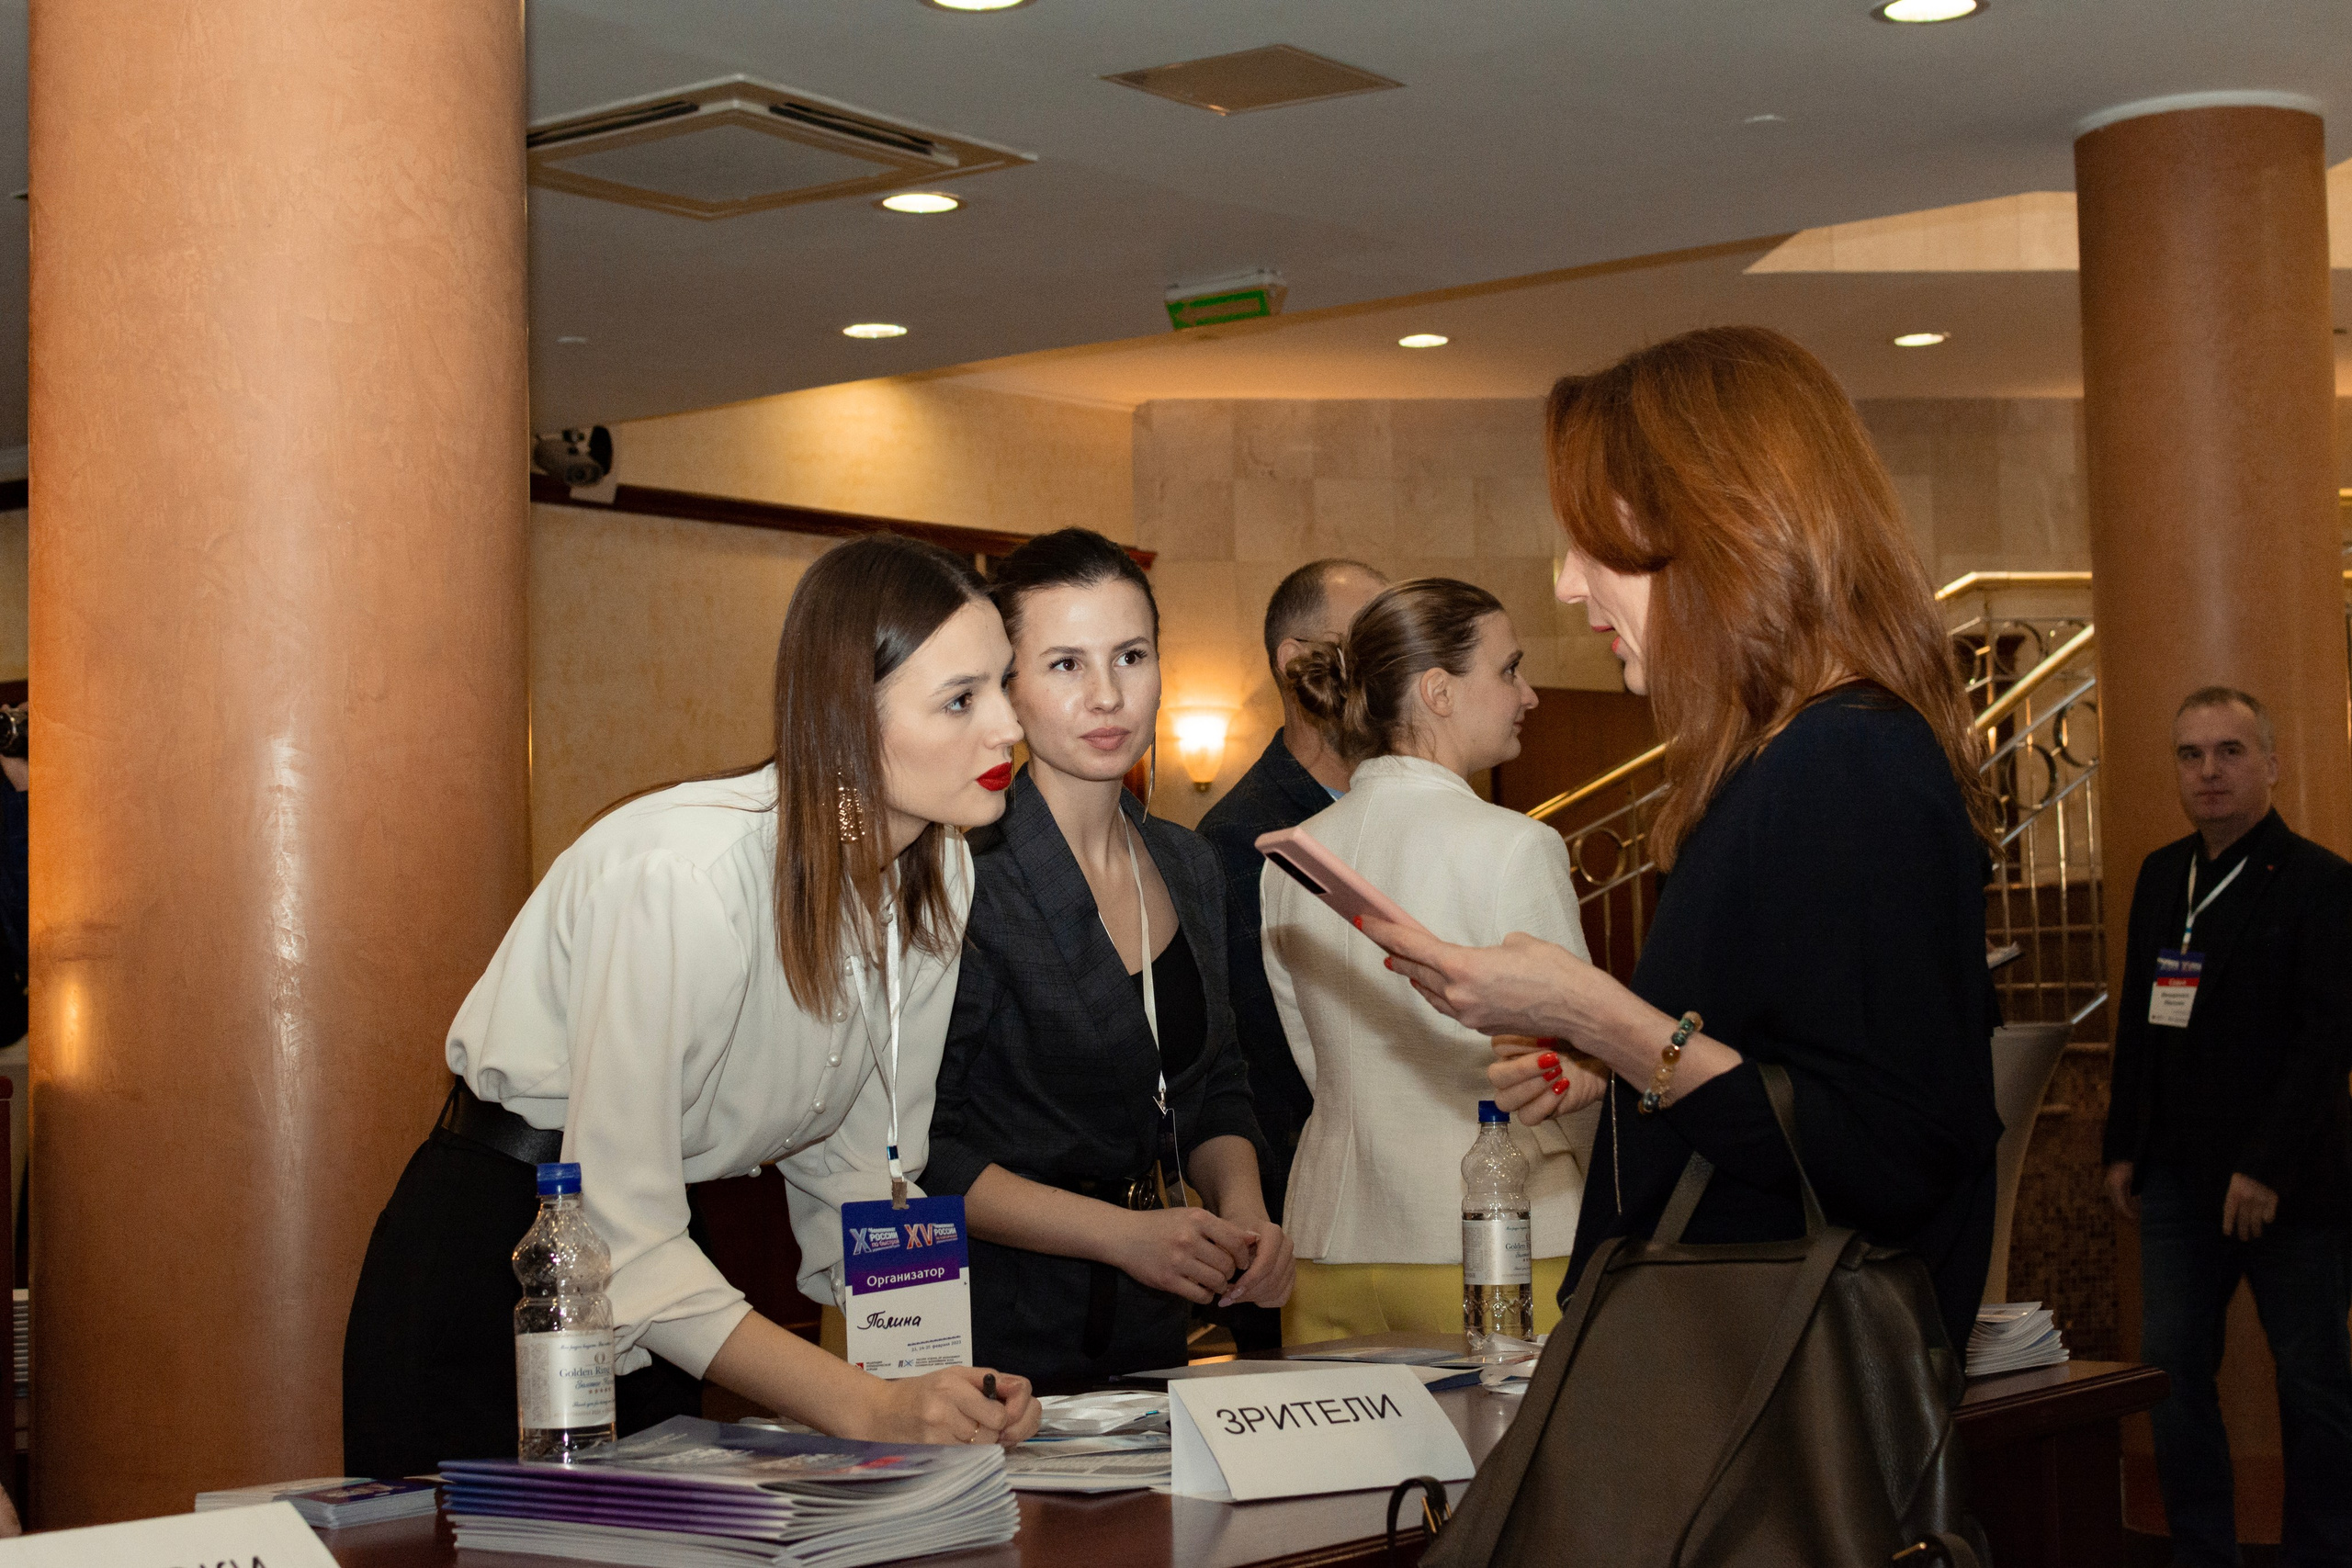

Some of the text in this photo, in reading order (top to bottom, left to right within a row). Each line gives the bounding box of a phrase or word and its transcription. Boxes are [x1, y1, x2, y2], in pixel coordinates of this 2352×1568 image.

[869, 1231, 899, 1242] РОССИИ
[933, 1227, 957, 1236] РОССИИ
[866, 1267, 945, 1288] Организатор
[856, 1310, 922, 1330] Полина
[559, 1367, 594, 1378] Golden
[1216, 1393, 1402, 1435] ЗРИТЕЛИ
